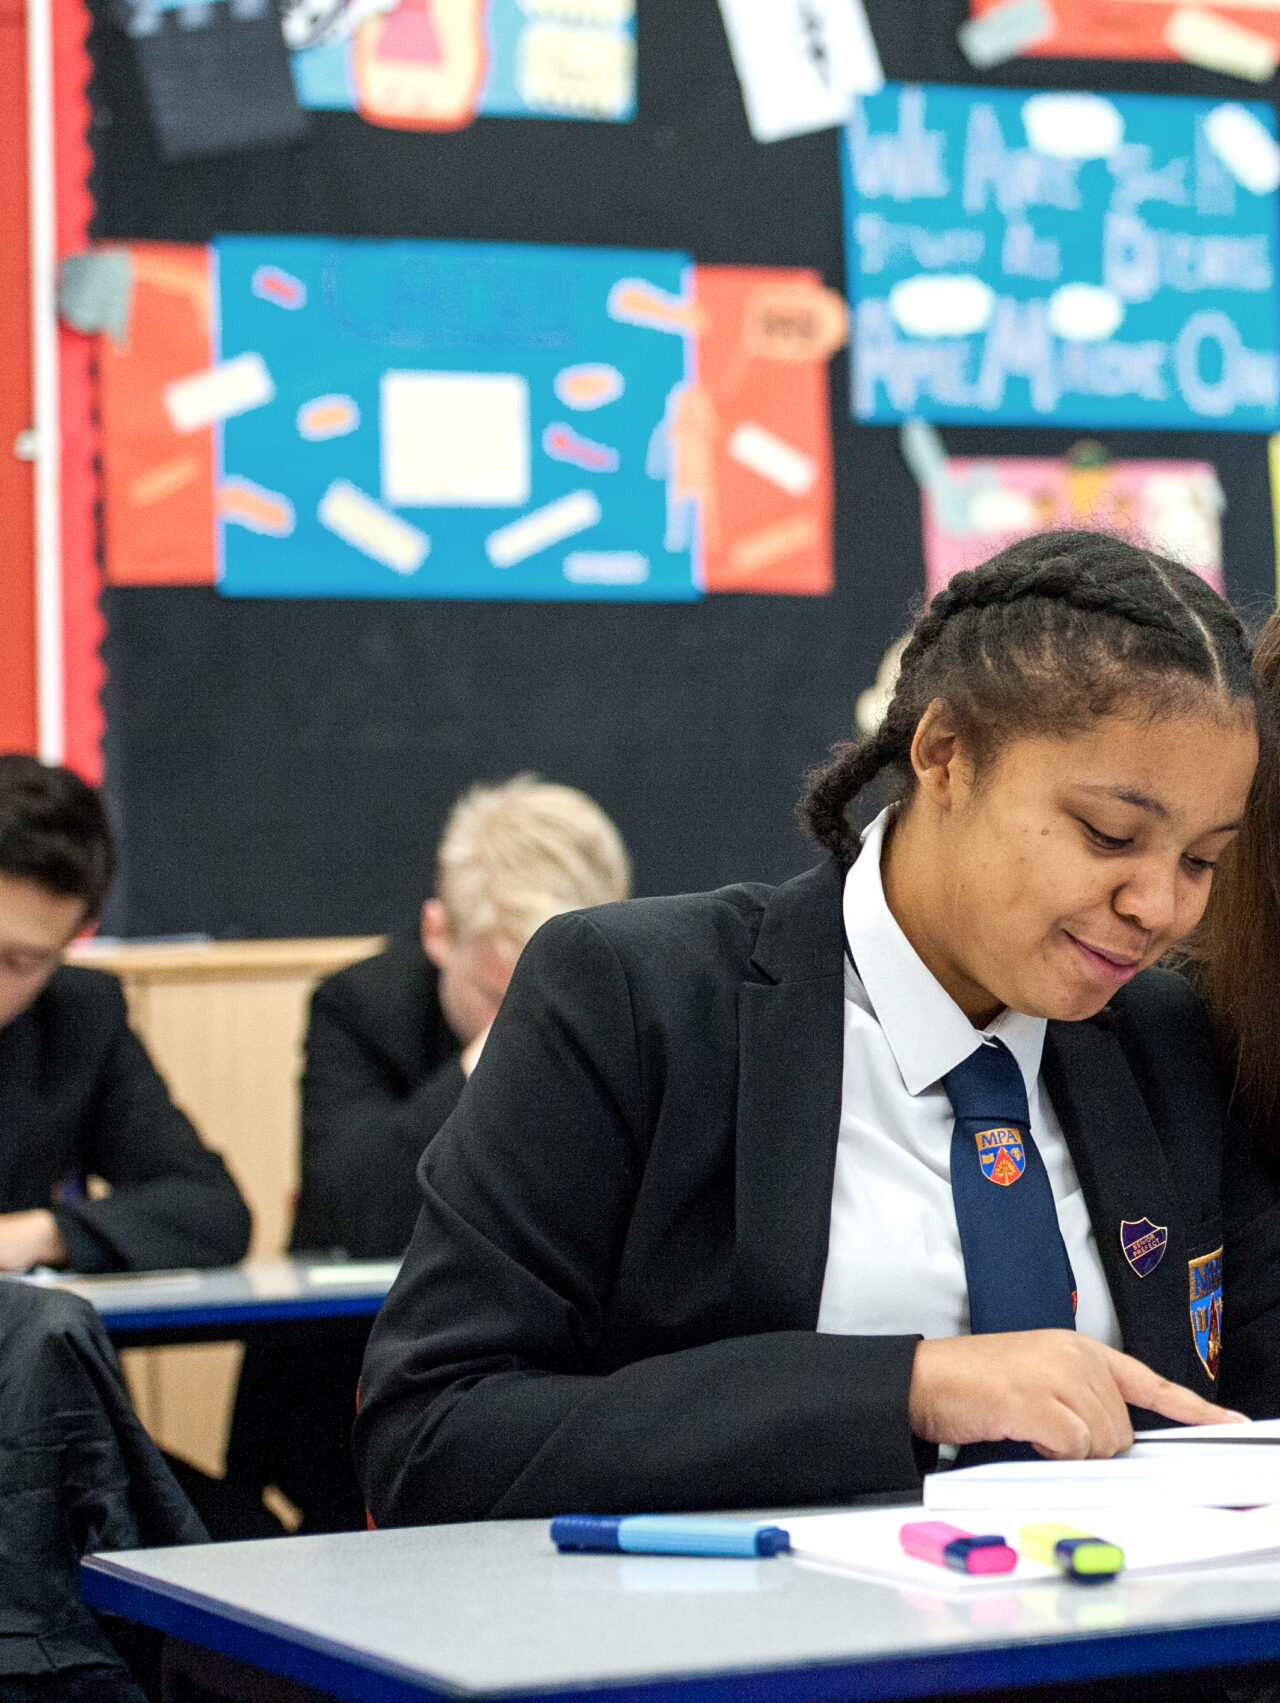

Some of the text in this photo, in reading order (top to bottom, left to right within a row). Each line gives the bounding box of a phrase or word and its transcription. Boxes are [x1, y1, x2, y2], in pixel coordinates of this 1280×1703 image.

[981, 1130, 1018, 1148] MPA
[1132, 1234, 1156, 1251] SENIOR
[1133, 1237, 1160, 1258] PREFECT
